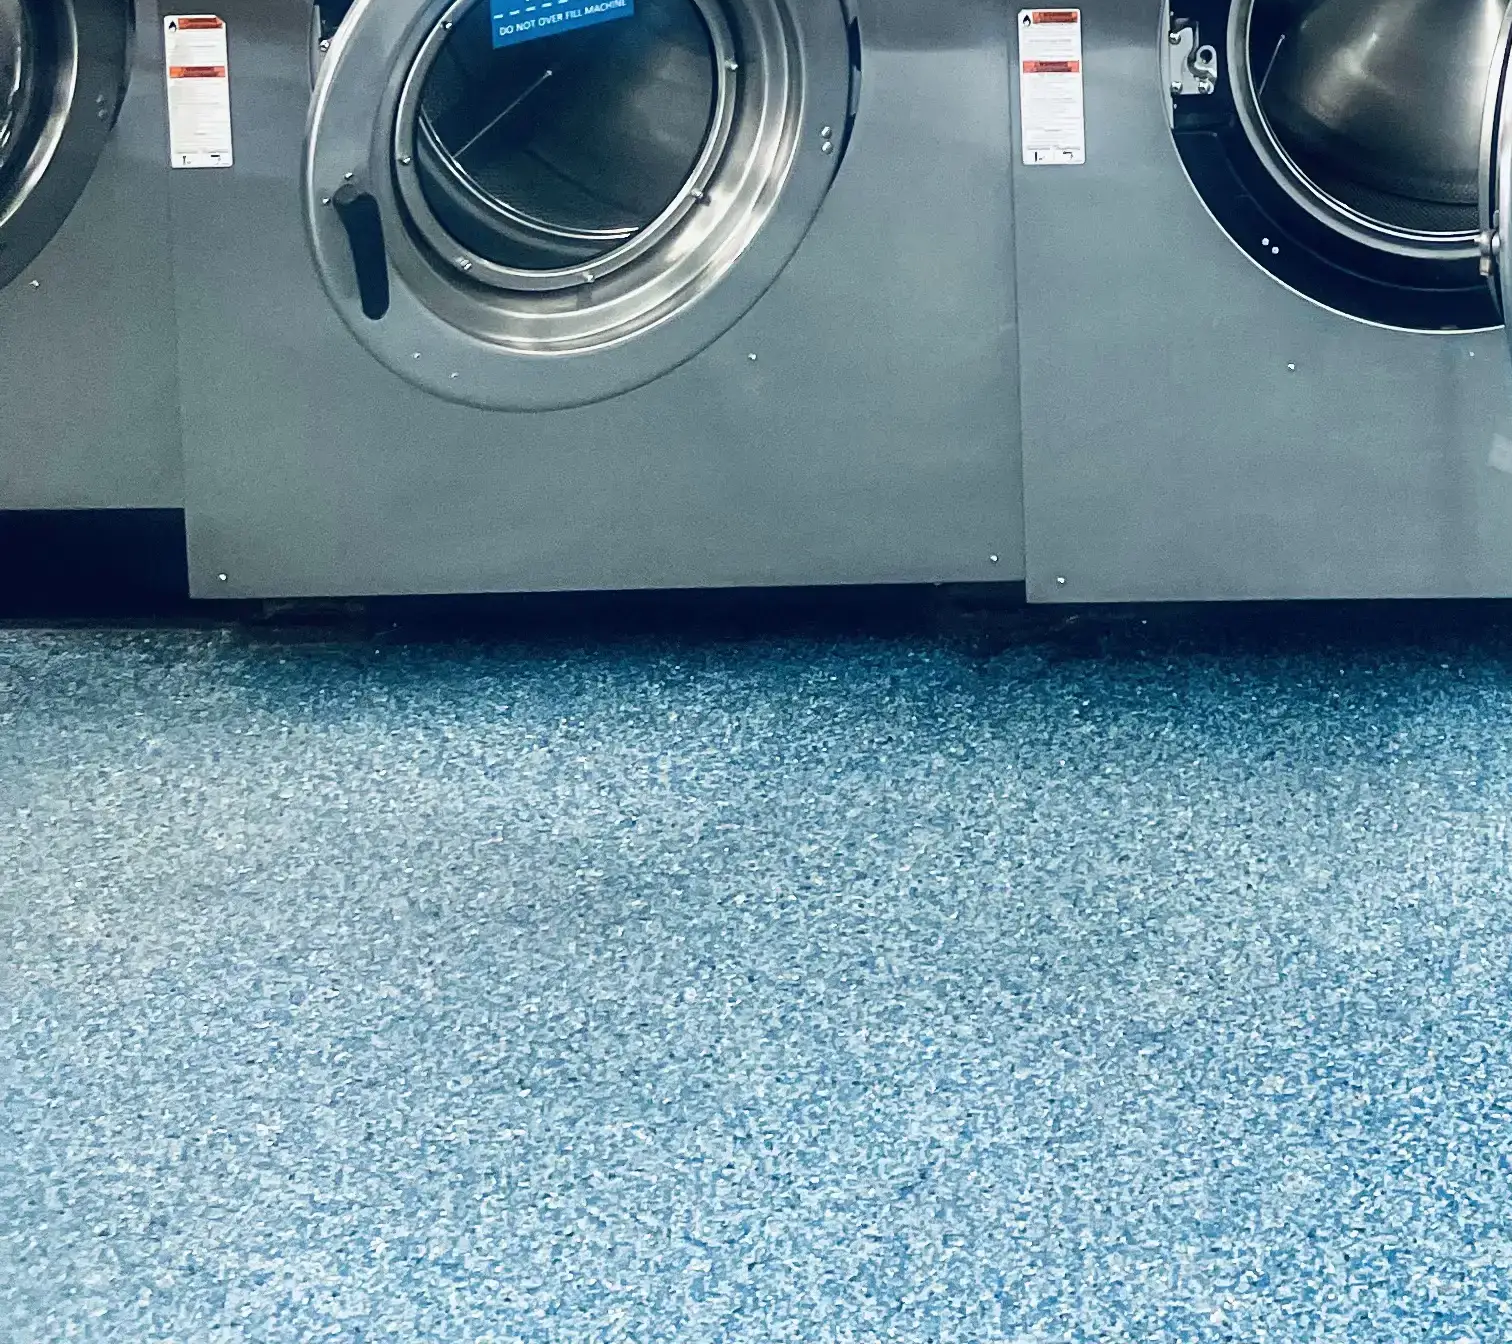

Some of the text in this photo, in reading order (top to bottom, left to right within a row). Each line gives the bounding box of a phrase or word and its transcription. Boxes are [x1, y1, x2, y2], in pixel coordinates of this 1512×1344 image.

[499, 25, 514, 36] DO
[515, 19, 536, 32] NOT
[538, 13, 563, 27] OVER
[565, 9, 582, 20] FILL
